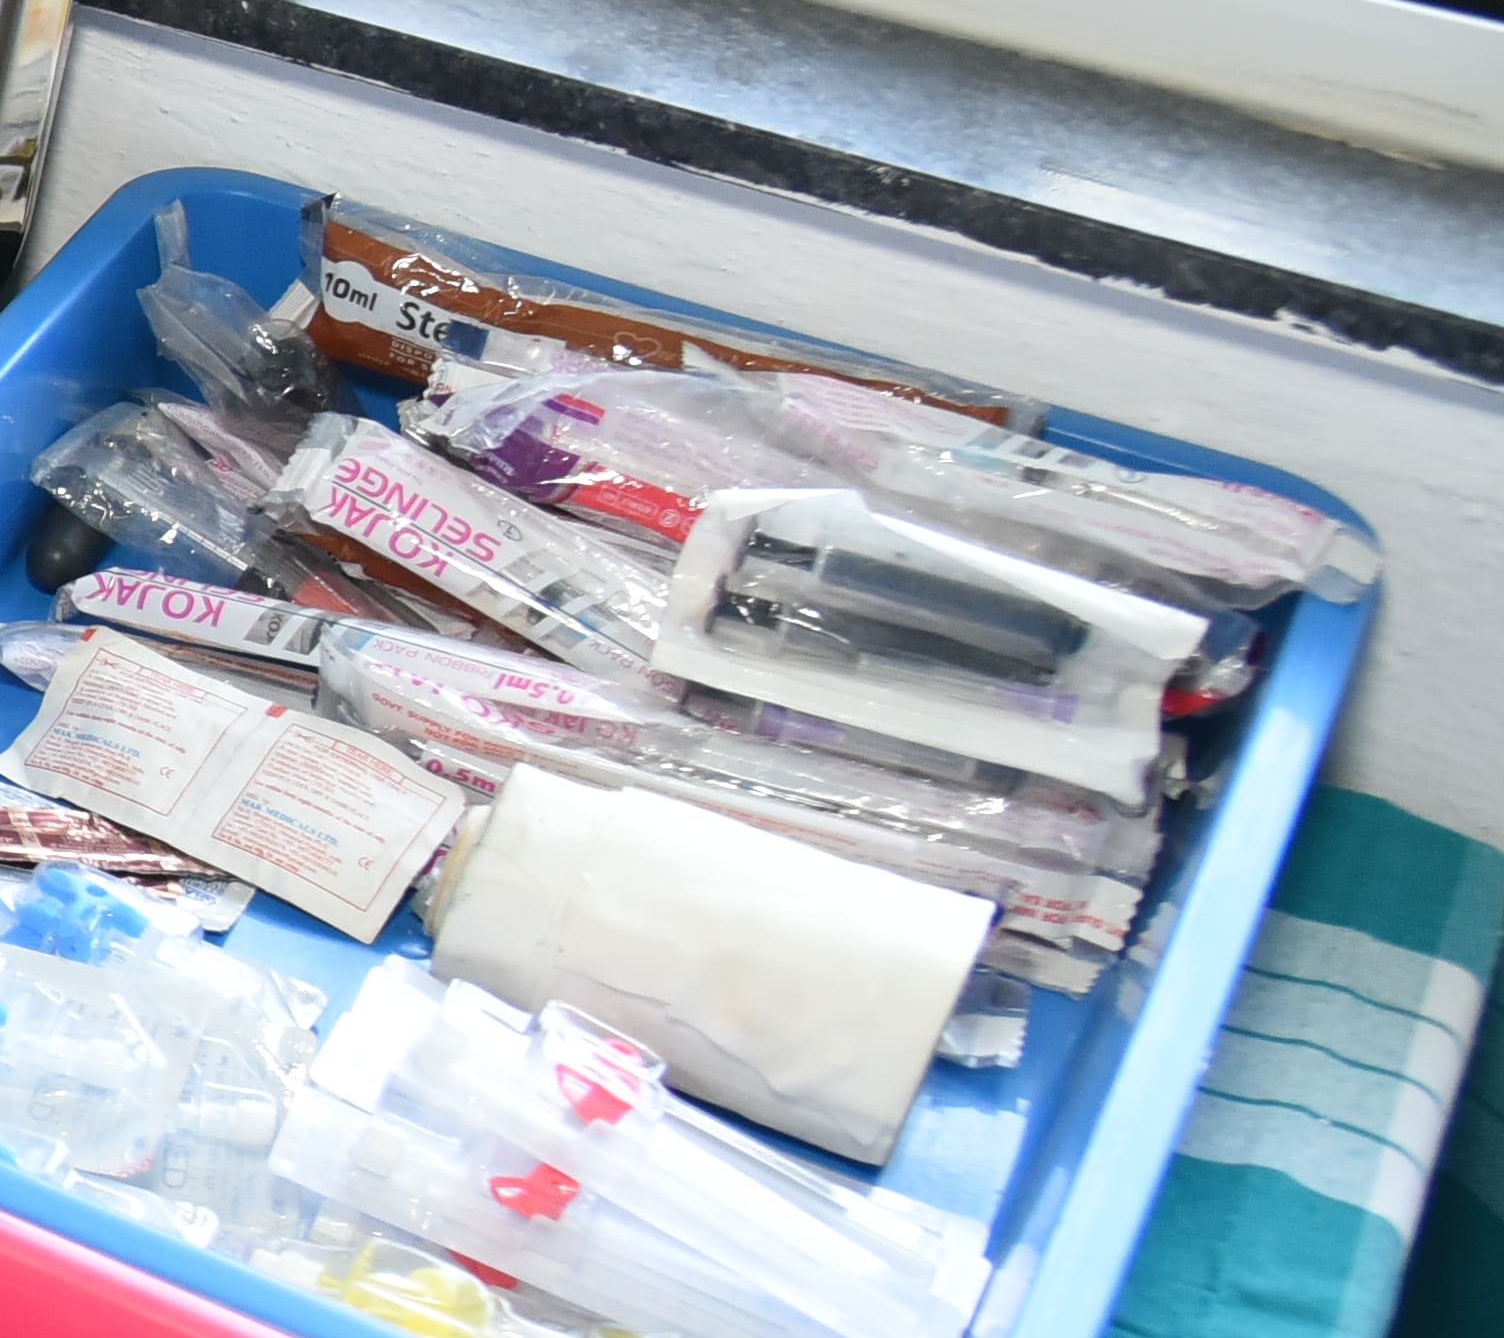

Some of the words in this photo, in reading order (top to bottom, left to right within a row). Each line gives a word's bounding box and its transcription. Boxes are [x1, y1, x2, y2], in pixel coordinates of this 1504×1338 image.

[321, 271, 378, 313] 10ml
[395, 299, 449, 345] Ste
[320, 482, 455, 575] KOJAK
[330, 455, 504, 567] SELINGE
[86, 570, 227, 630] KOJAK
[369, 635, 420, 660] PACK
[491, 671, 577, 706] 0.5ml
[424, 756, 499, 794] 0.5m
